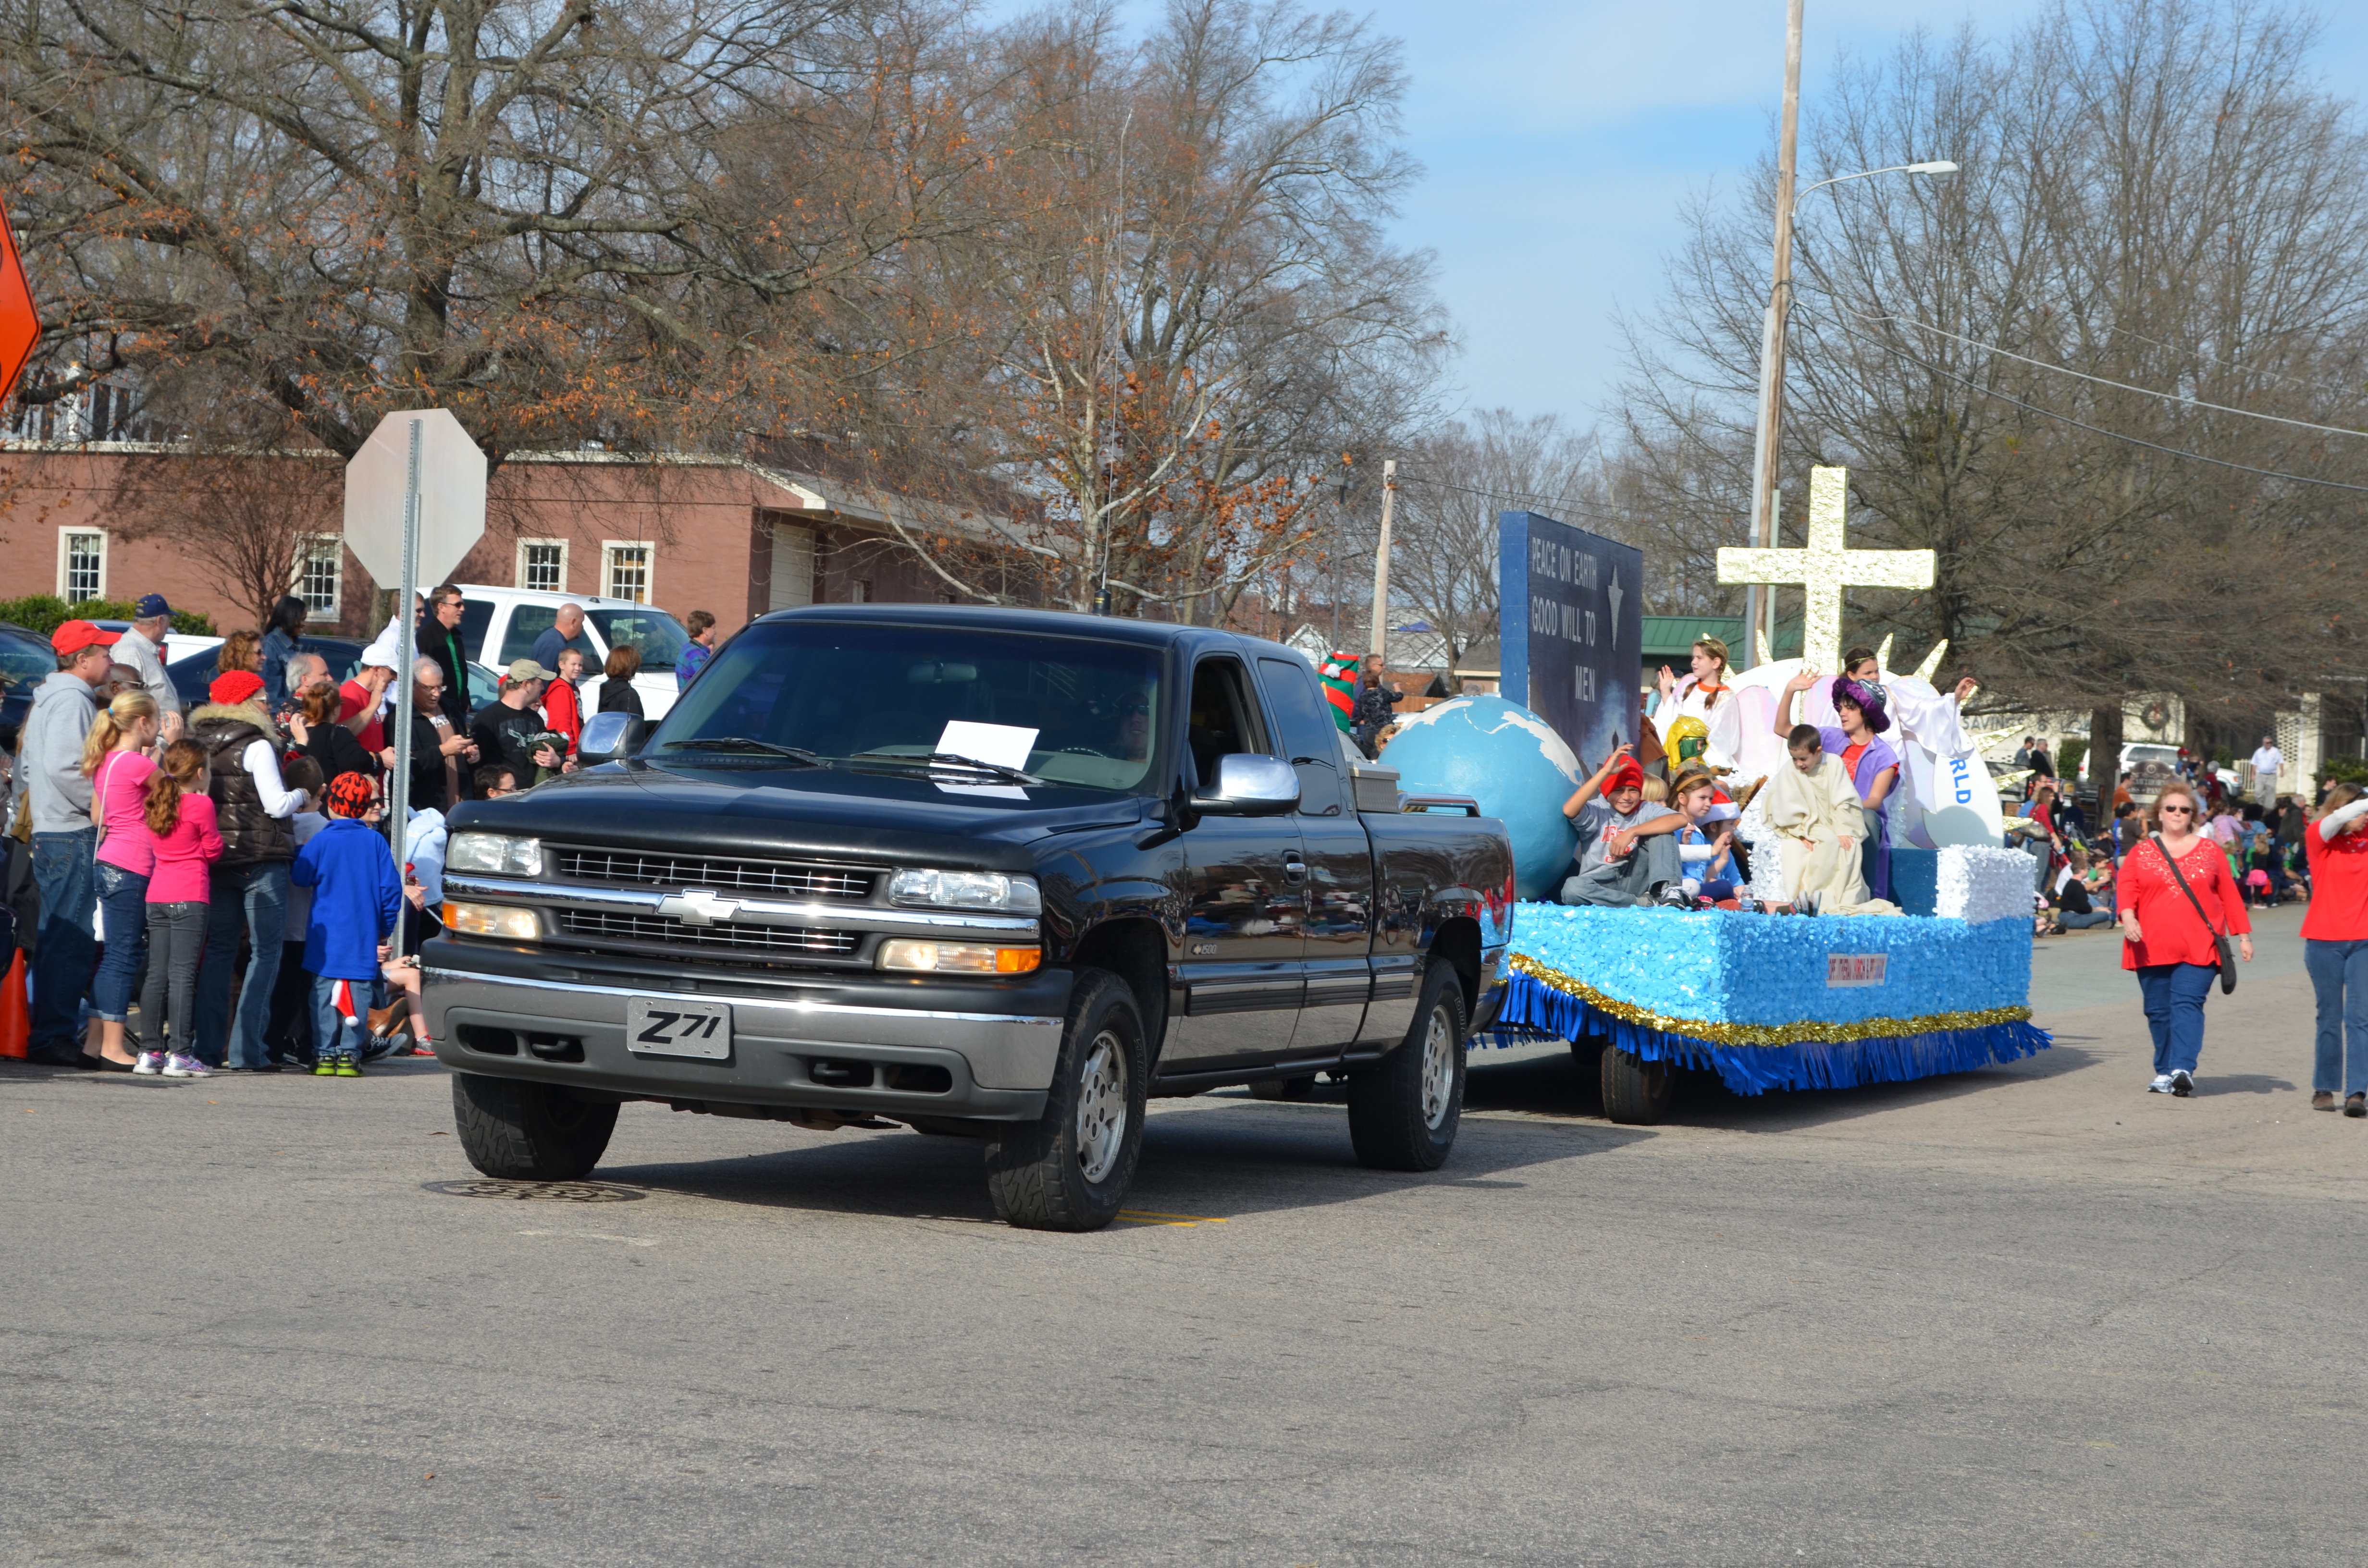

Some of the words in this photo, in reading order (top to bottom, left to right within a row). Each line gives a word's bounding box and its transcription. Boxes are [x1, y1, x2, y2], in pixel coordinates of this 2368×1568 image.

[1532, 537, 1556, 578] PEACE
[1560, 545, 1571, 582] ON
[1575, 551, 1597, 590] EARTH
[1532, 595, 1558, 636] GOOD
[1562, 603, 1581, 643] WILL
[1585, 610, 1596, 647] TO
[1575, 665, 1595, 702] MEN
[1949, 760, 1971, 804] RLD
[1201, 944, 1217, 955] 1500
[637, 1010, 721, 1044] Z71
